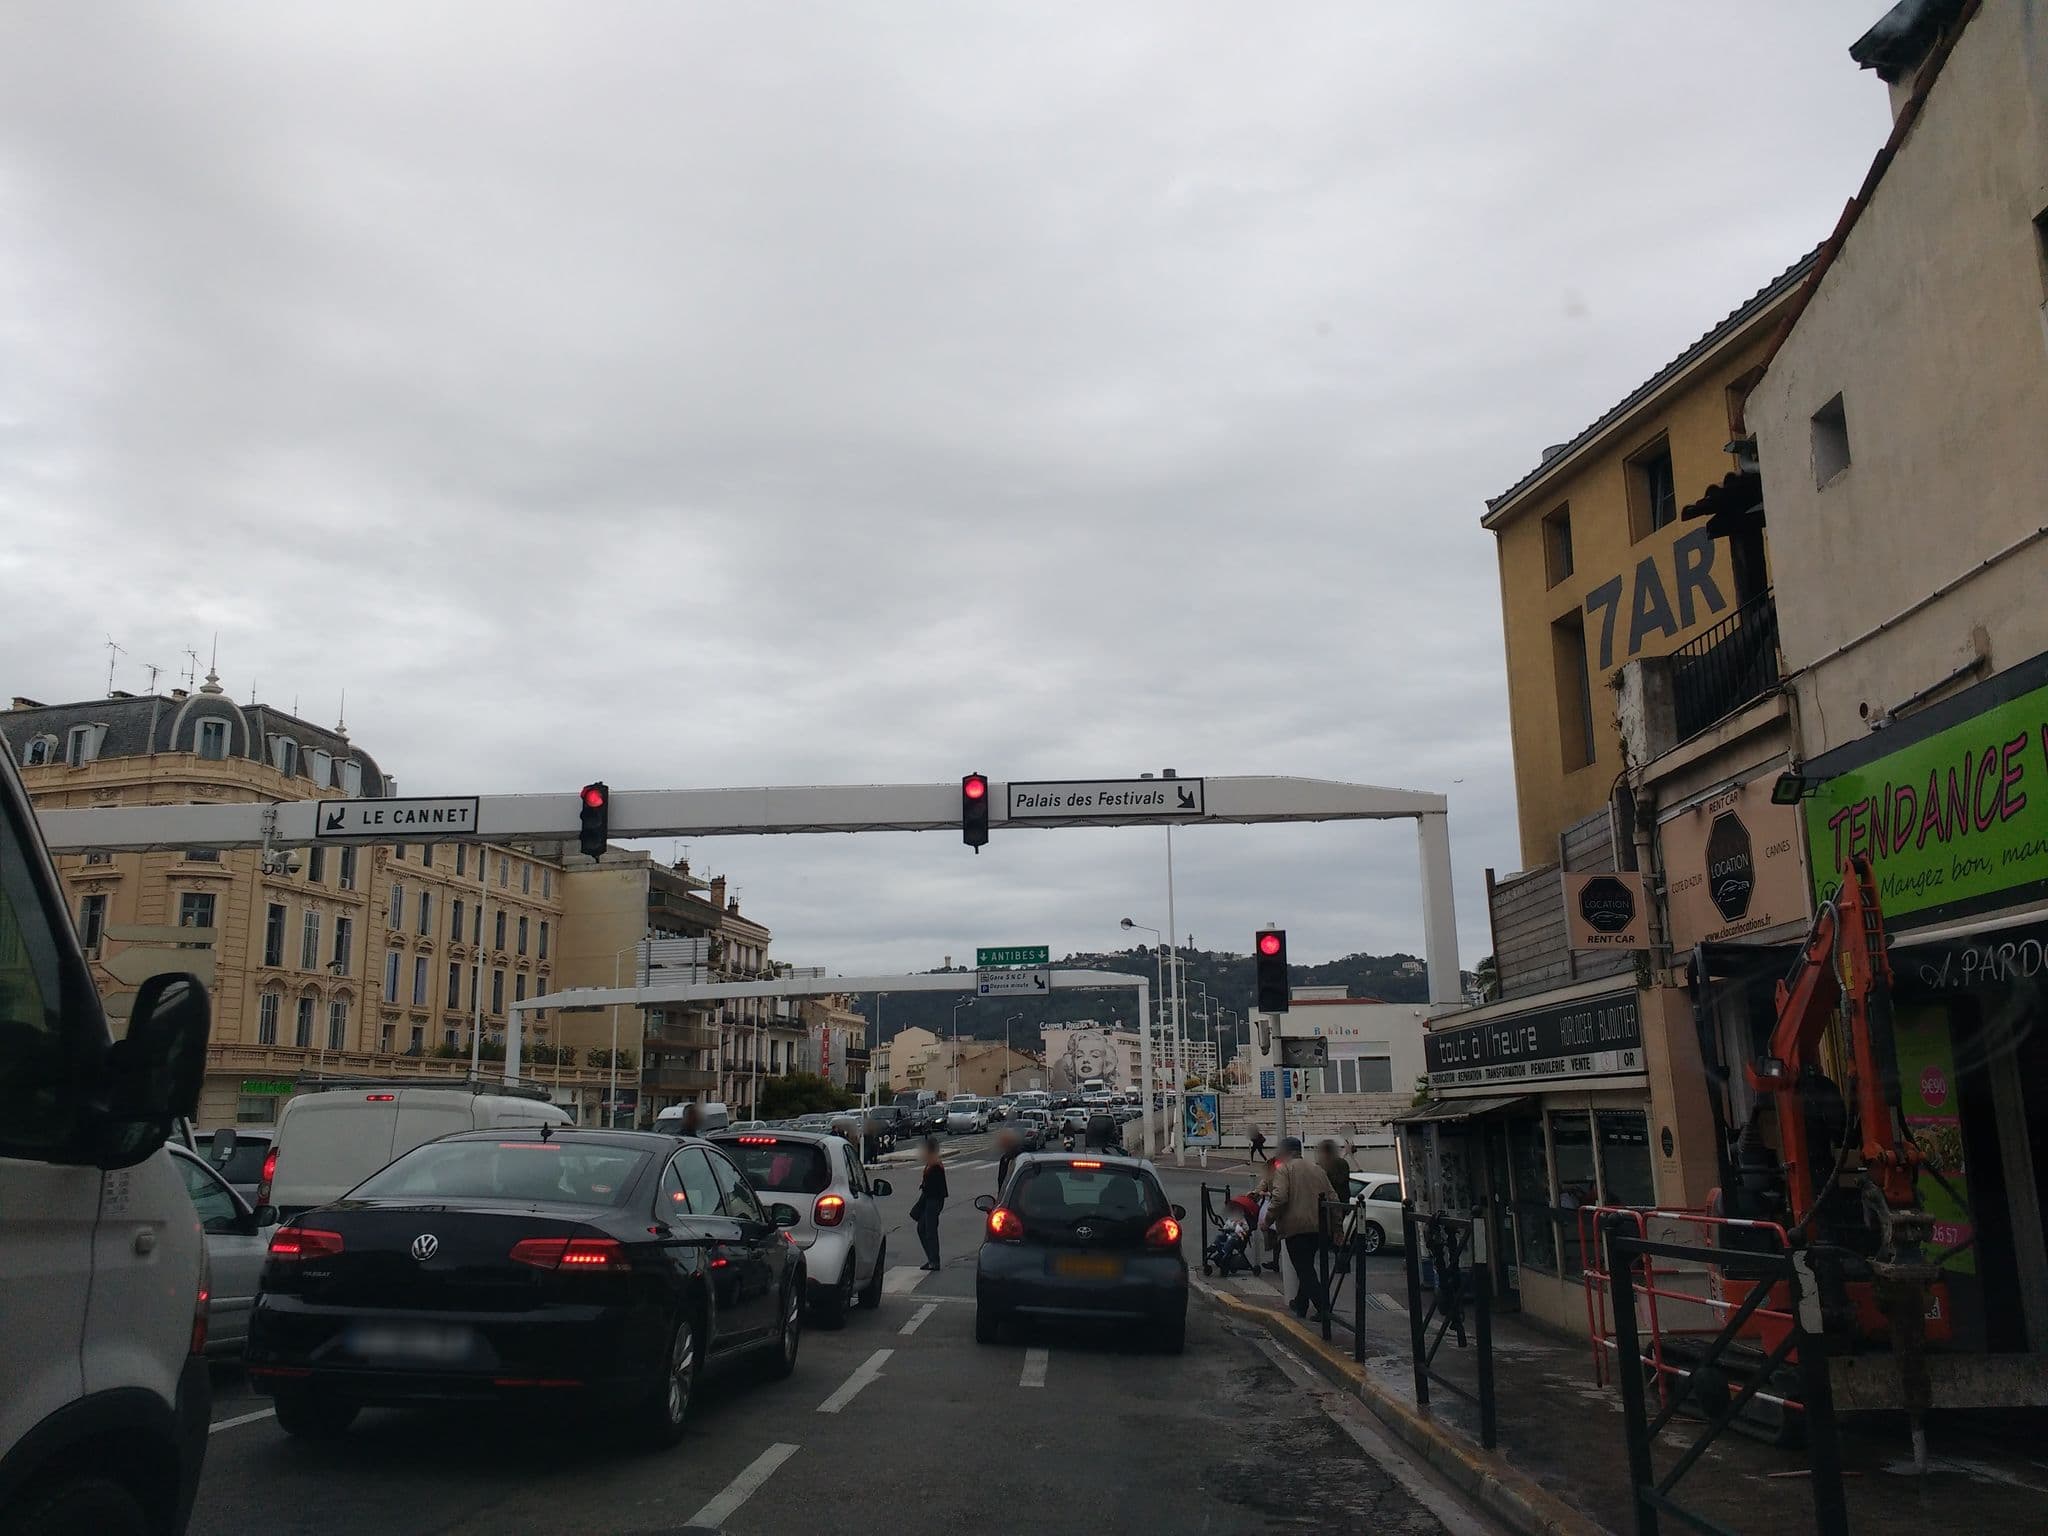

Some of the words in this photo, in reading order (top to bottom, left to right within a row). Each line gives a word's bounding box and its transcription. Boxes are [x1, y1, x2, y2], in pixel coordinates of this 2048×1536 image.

[1016, 793, 1061, 808] Palais
[1067, 792, 1092, 807] des
[1098, 790, 1165, 806] Festivals
[1708, 797, 1725, 814] RENT
[1725, 791, 1738, 807] CAR
[1828, 731, 2028, 875] TENDANCE
[363, 810, 384, 825] LE
[393, 808, 469, 824] CANNET
[1765, 839, 1791, 859] CANNES
[1711, 853, 1749, 880] LOCATION
[1881, 867, 1944, 899] Mangez
[1952, 854, 1993, 882] bon,
[1585, 899, 1629, 909] LOCATION
[1587, 935, 1614, 944] RENT
[1615, 935, 1635, 944] CAR
[991, 950, 1035, 961] ANTIBES
[1919, 939, 2048, 989] A.PARD
[1560, 1012, 1593, 1048] HORLOGER
[1598, 1004, 1636, 1042] BIJOUTIER
[1439, 1035, 1467, 1064] tout
[1484, 1025, 1538, 1057] l'heure
[1485, 1063, 1526, 1079] TRANSFORMATION
[1530, 1060, 1565, 1075] PENDULERIE
[1570, 1057, 1591, 1071] VENTE
[1624, 1052, 1635, 1067] OR
